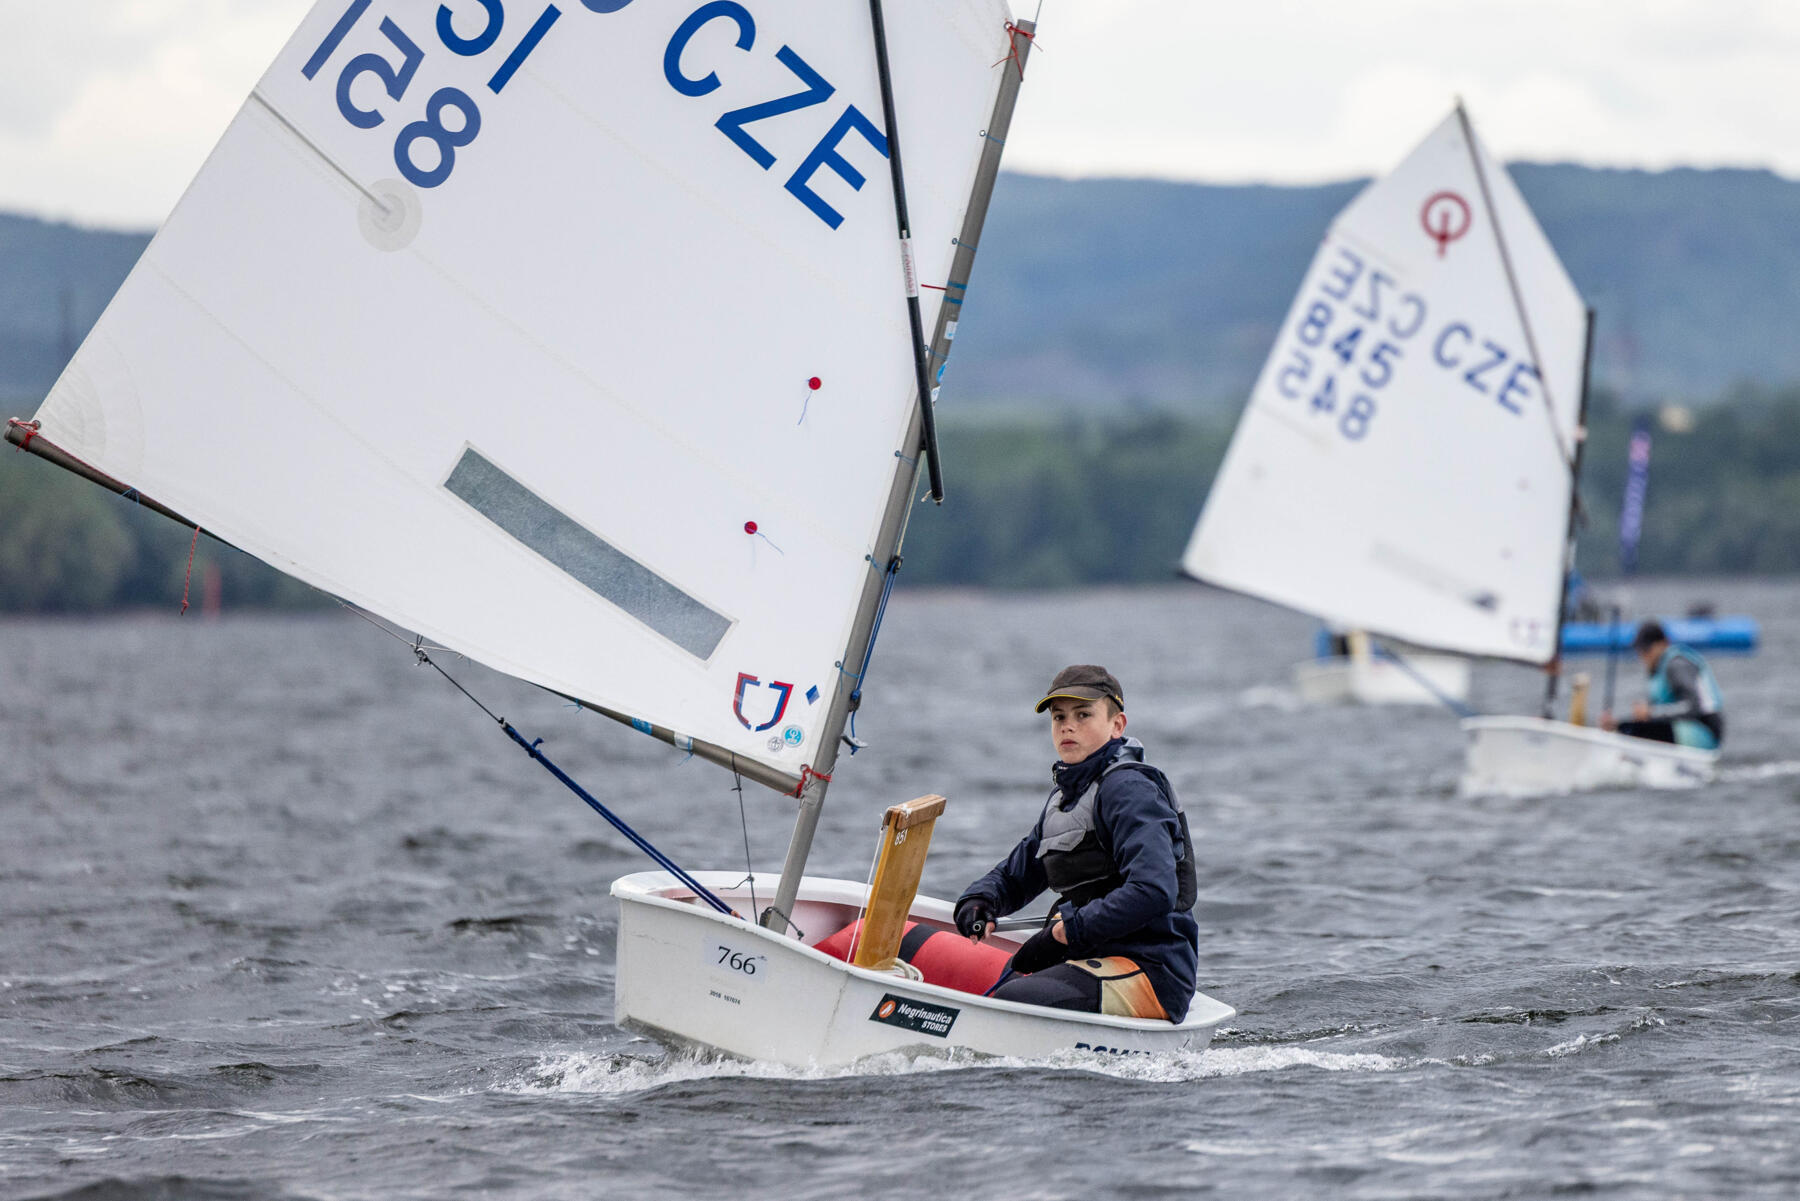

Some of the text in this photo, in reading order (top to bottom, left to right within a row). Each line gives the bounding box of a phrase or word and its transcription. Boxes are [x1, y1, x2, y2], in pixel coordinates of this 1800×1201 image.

[663, 0, 890, 231] CZE
[1297, 301, 1402, 390] 845
[1433, 321, 1541, 416] CZE
[718, 946, 756, 975] 766
[921, 1020, 949, 1033] STORES
